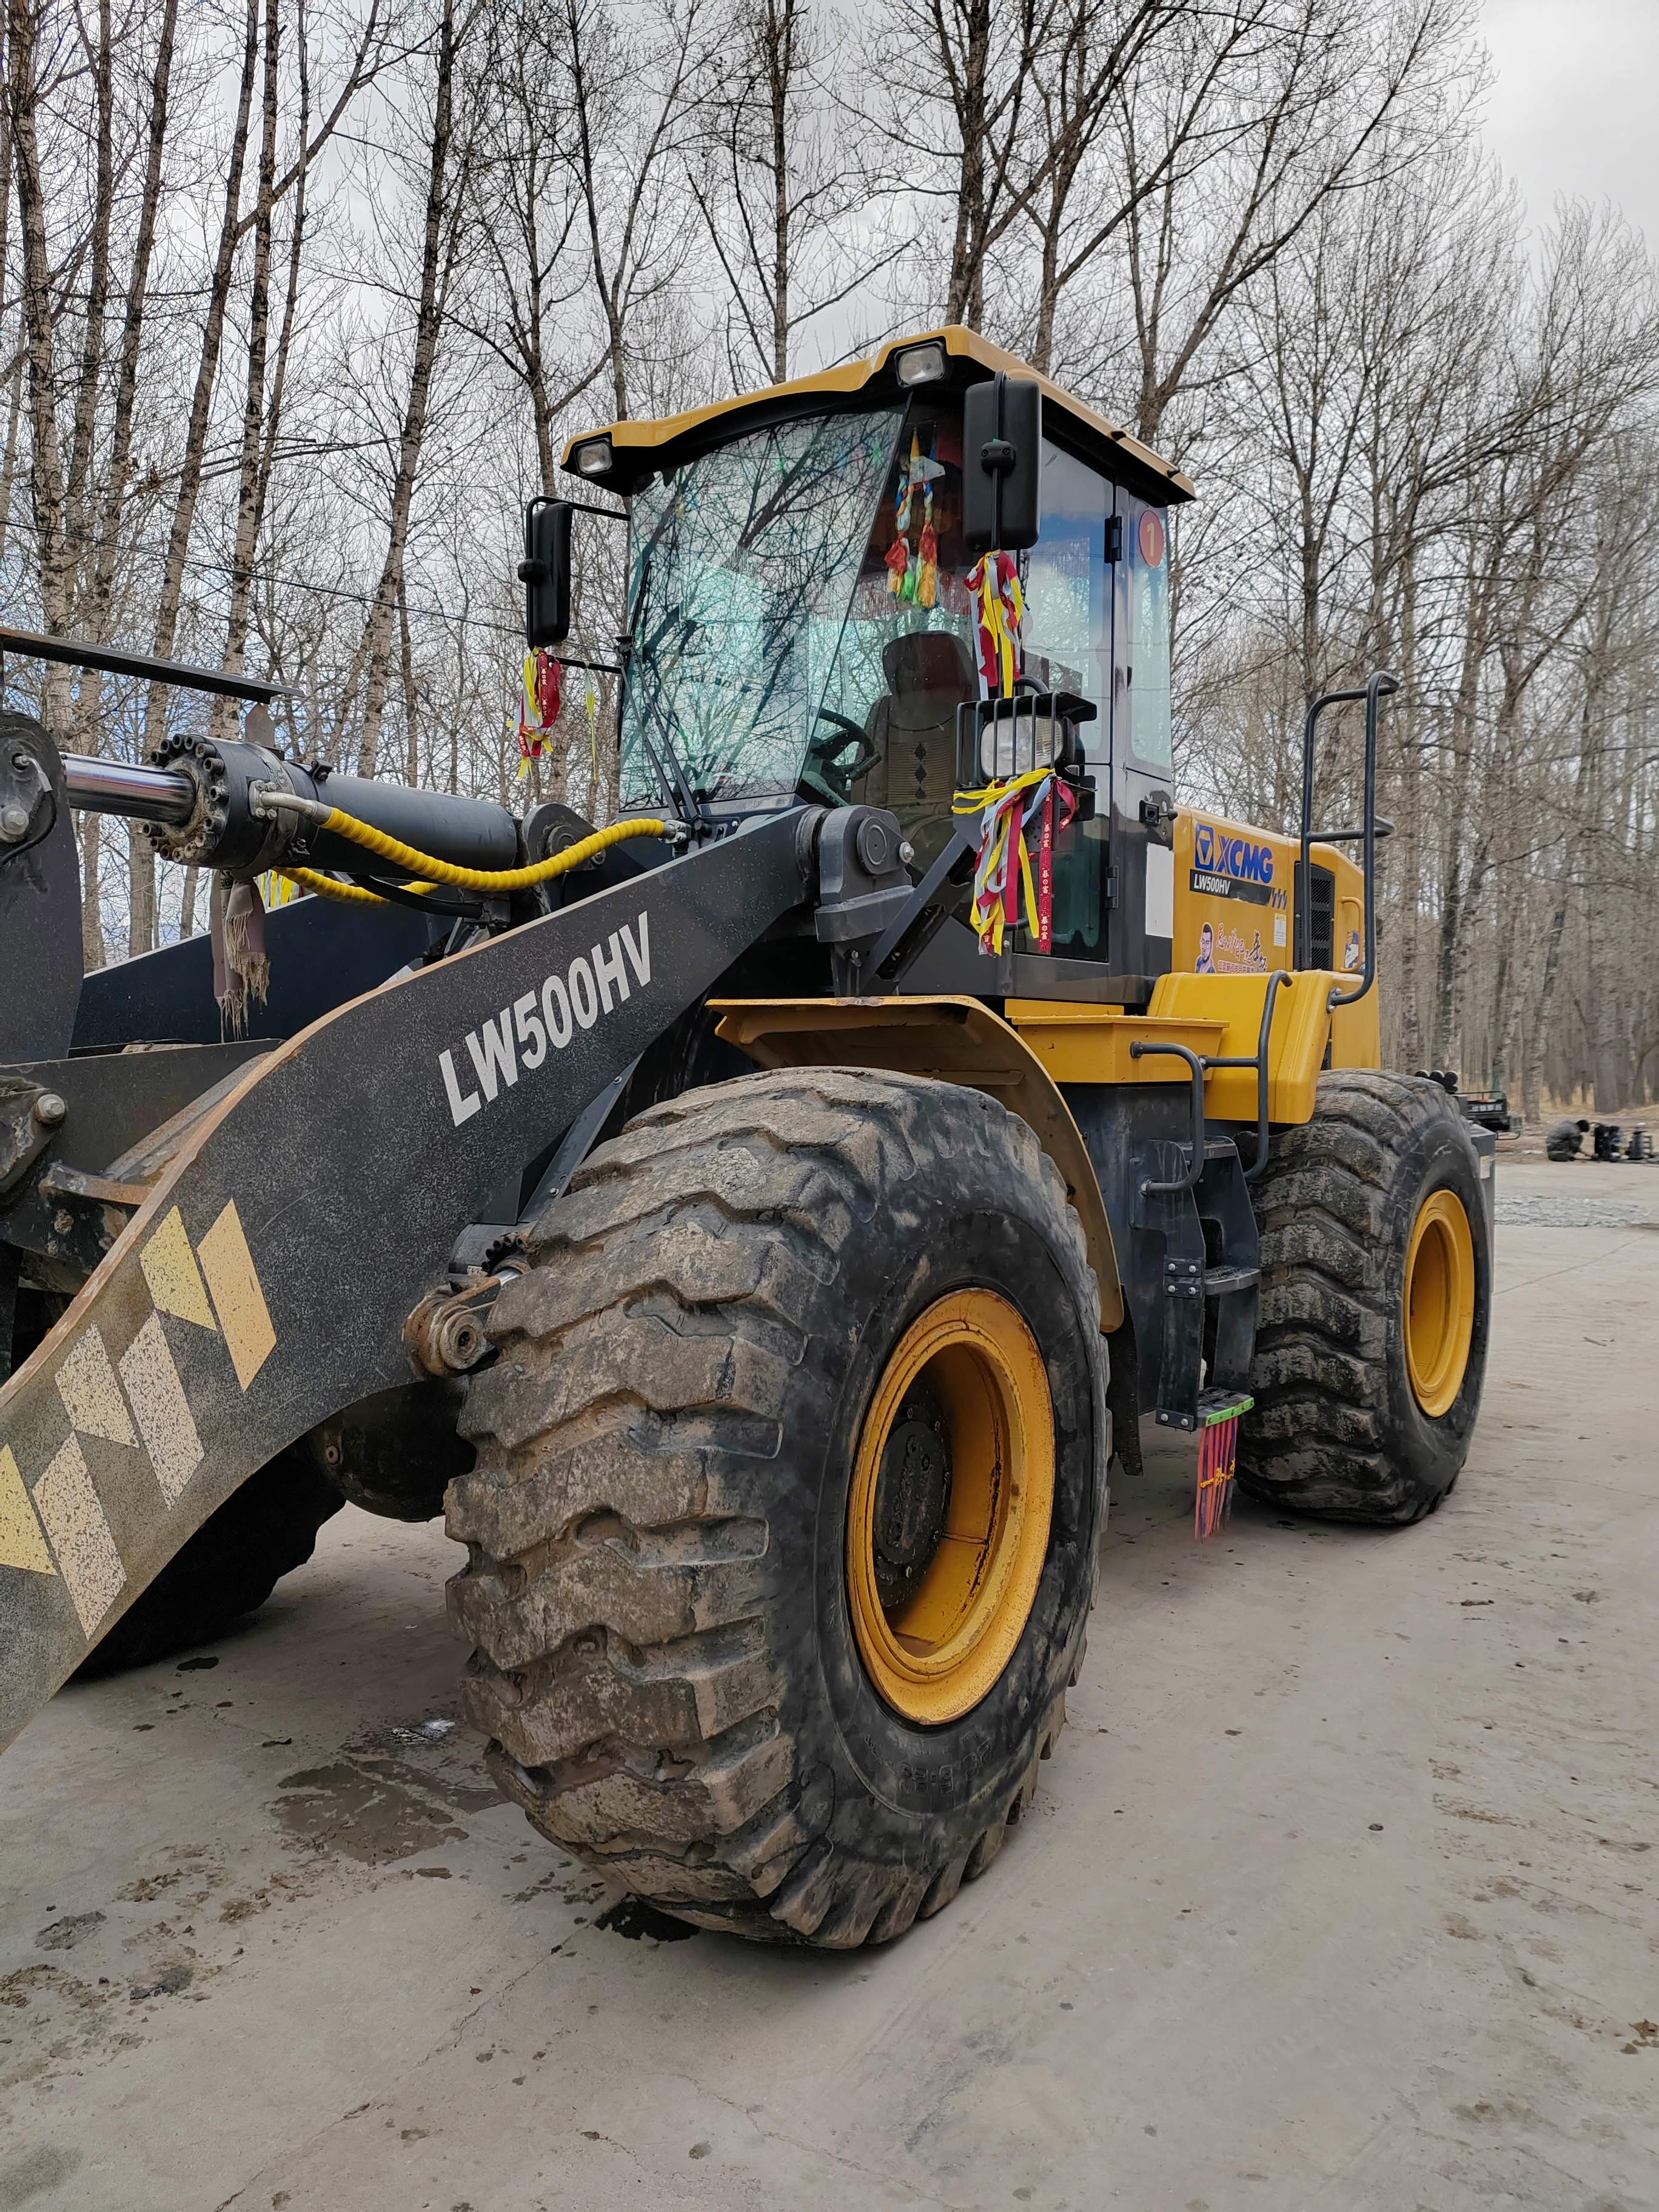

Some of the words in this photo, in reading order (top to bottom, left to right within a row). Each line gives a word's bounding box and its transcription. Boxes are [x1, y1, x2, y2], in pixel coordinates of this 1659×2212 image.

[1193, 873, 1232, 895] LW500HV
[1215, 834, 1273, 884] XCMG
[438, 910, 651, 1128] LW500HV
